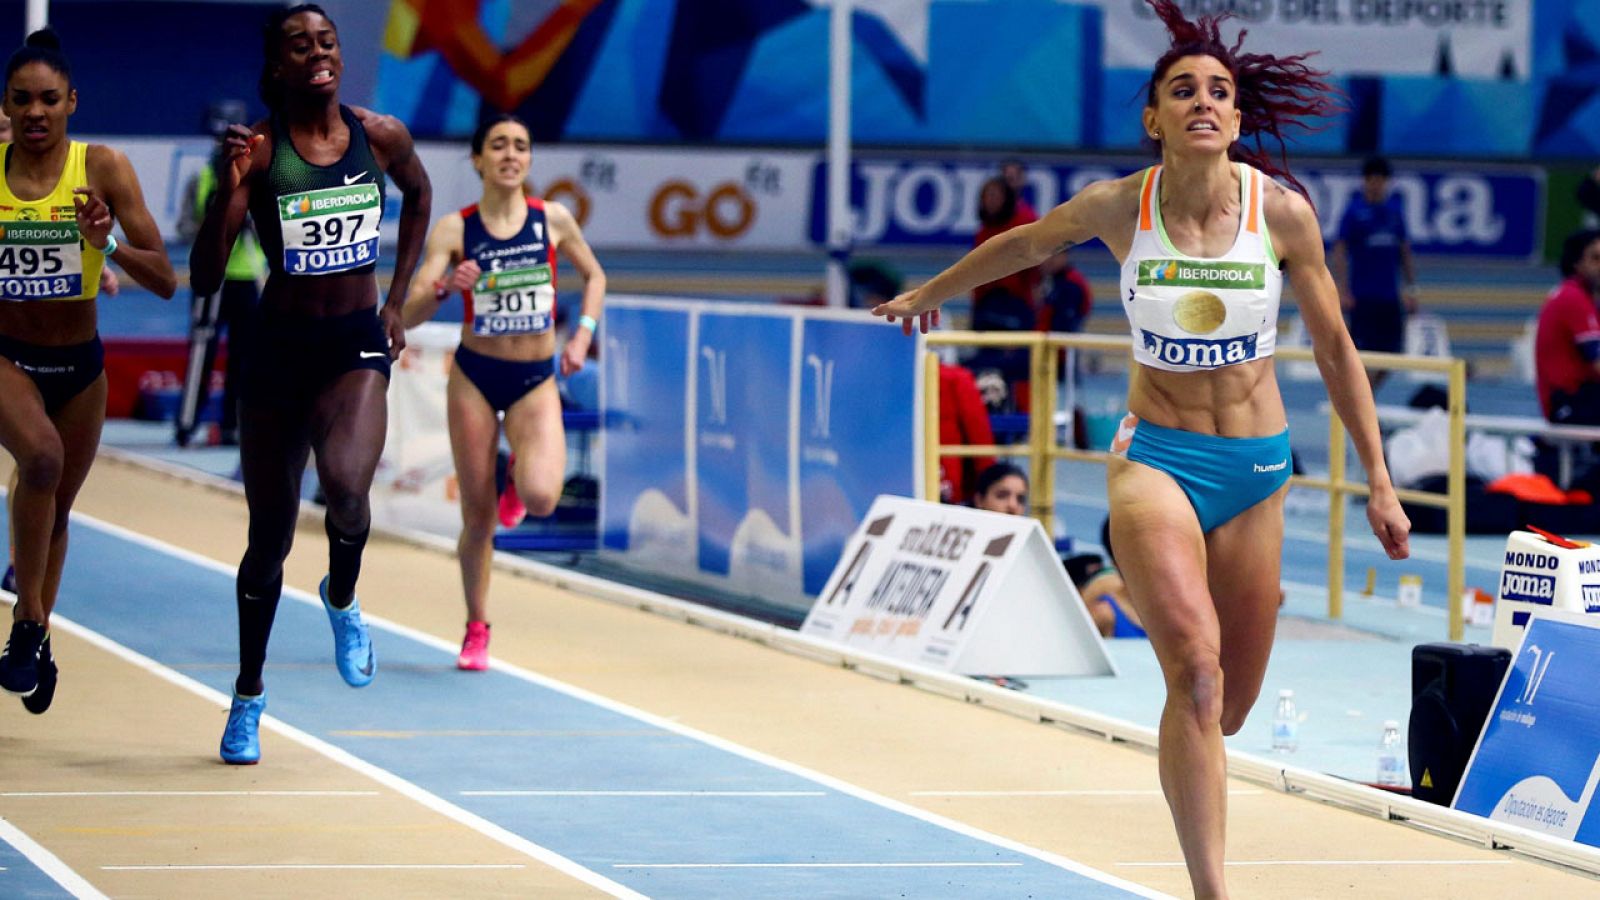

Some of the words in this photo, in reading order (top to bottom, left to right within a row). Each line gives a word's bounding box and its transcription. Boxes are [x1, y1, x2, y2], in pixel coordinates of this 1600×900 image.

[1131, 0, 1275, 24] CUDAD
[311, 193, 375, 211] IBERDROLA
[649, 179, 756, 239] GO
[7, 228, 73, 240] IBERDROLA
[302, 214, 365, 246] 397
[0, 247, 63, 275] 495
[294, 243, 370, 272] Joma
[1179, 267, 1254, 281] IBERDROLA
[488, 291, 536, 312] 301
[1149, 335, 1246, 366] Joma
[1504, 551, 1560, 570] MONDO
[1503, 573, 1553, 599] Joma
